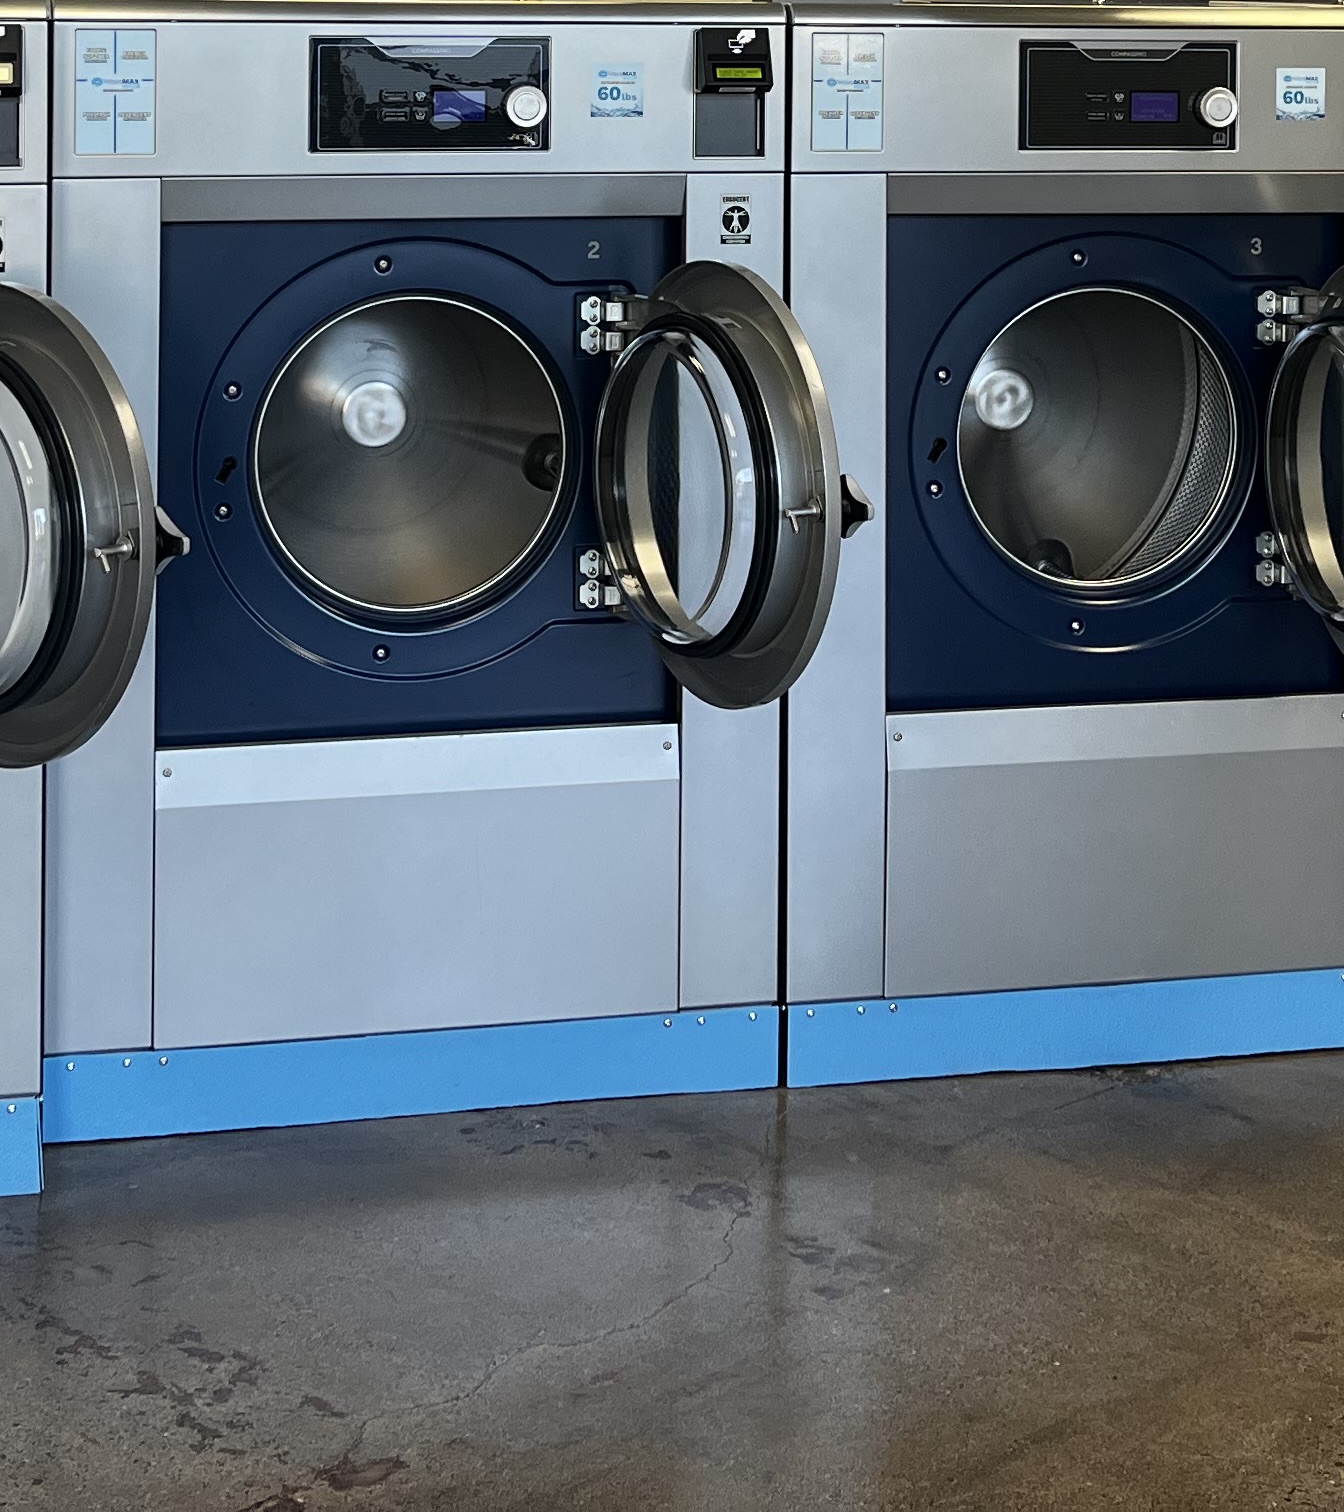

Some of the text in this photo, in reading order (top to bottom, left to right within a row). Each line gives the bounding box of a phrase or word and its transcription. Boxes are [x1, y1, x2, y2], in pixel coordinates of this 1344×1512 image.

[597, 86, 638, 101] 60 lbs
[1283, 90, 1304, 105] 60
[587, 240, 601, 259] 2
[1250, 237, 1263, 255] 3
